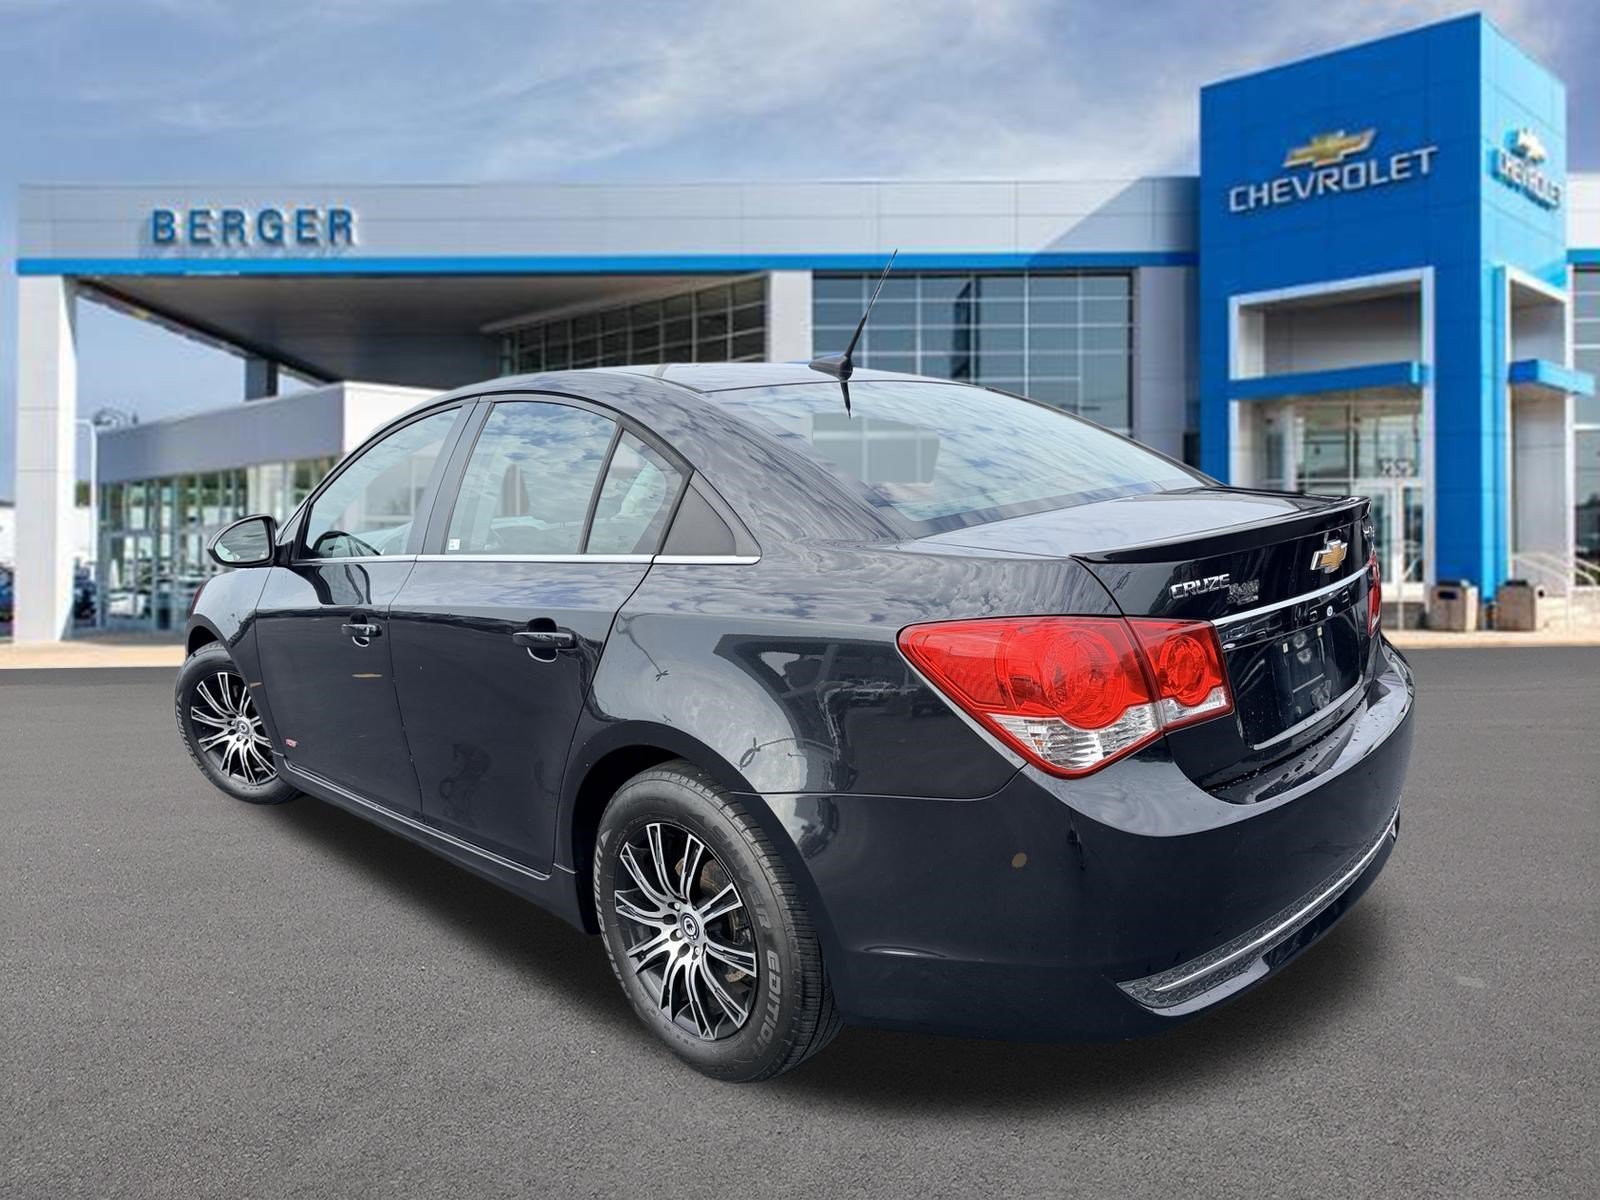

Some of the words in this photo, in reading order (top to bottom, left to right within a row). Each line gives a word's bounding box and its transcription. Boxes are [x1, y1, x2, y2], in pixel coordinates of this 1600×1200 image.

[1229, 146, 1438, 212] CHEVROLET
[1499, 149, 1562, 207] CHEVROLE
[153, 209, 354, 245] BERGER
[1170, 574, 1230, 599] CRUZE
[752, 949, 781, 1049] EDITION
